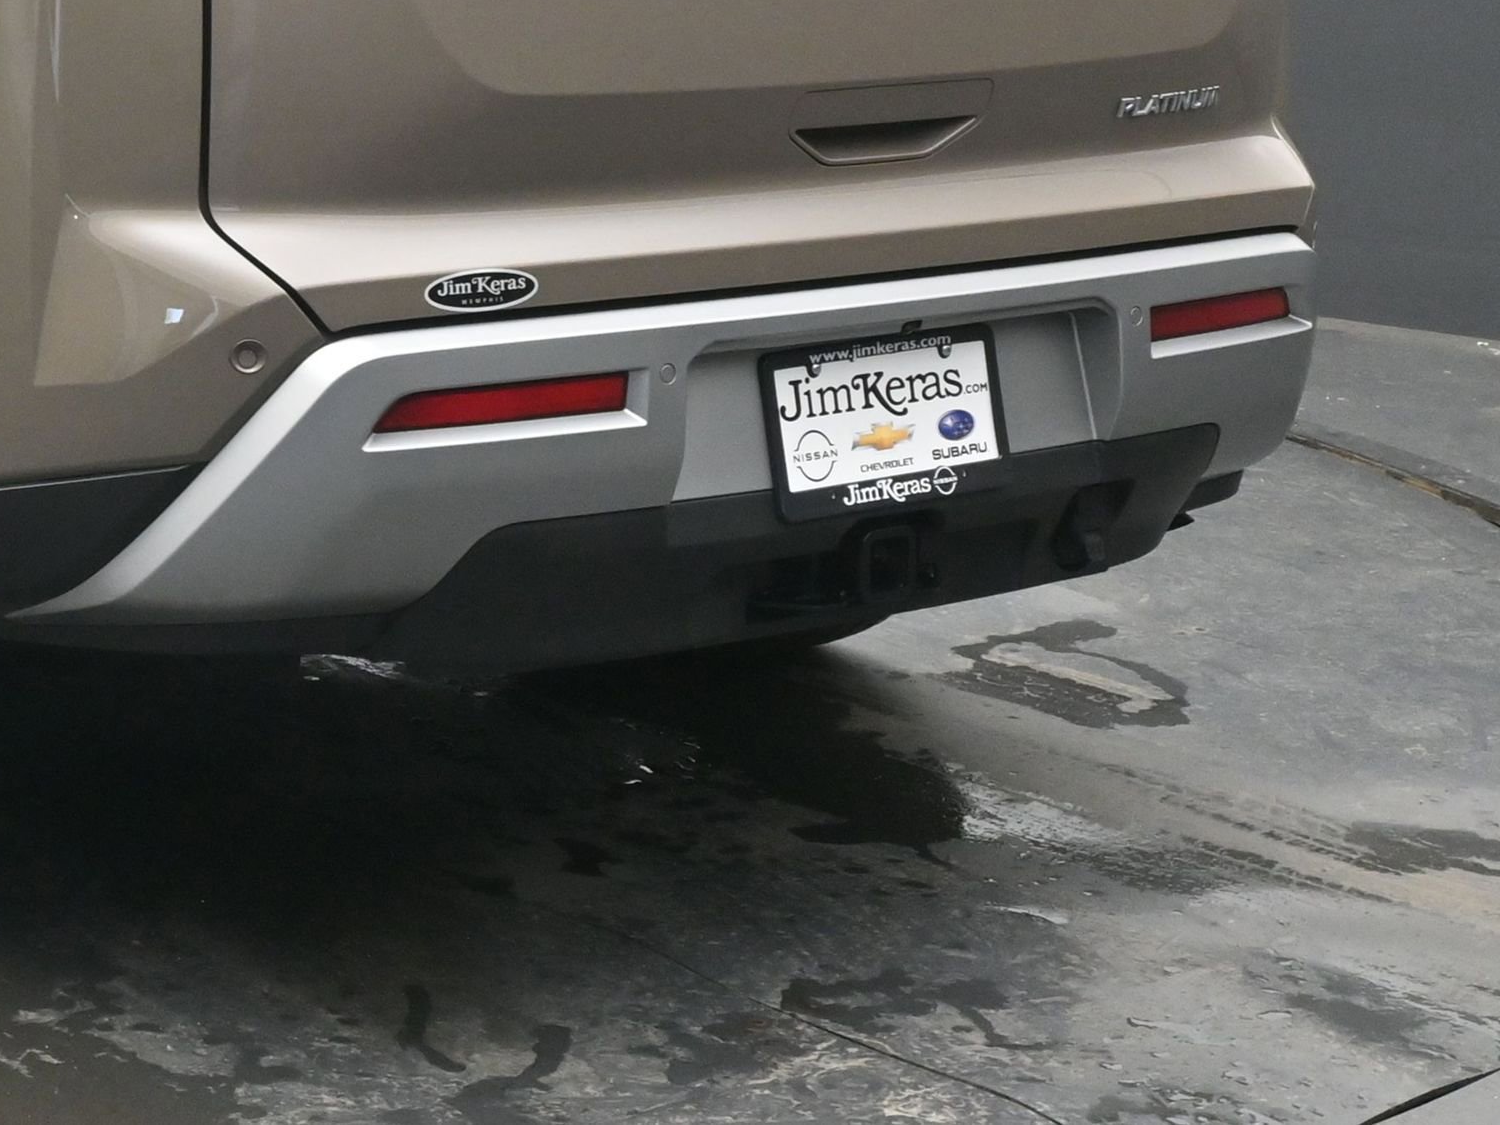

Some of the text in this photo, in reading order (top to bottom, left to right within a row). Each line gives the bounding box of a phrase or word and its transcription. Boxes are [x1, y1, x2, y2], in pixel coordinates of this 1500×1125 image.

[1117, 85, 1220, 117] PLATINUM
[809, 335, 951, 364] www.jimkeras.com
[793, 448, 838, 463] NISSAN
[932, 442, 988, 461] SUBARU
[860, 457, 914, 473] CHEVROLET
